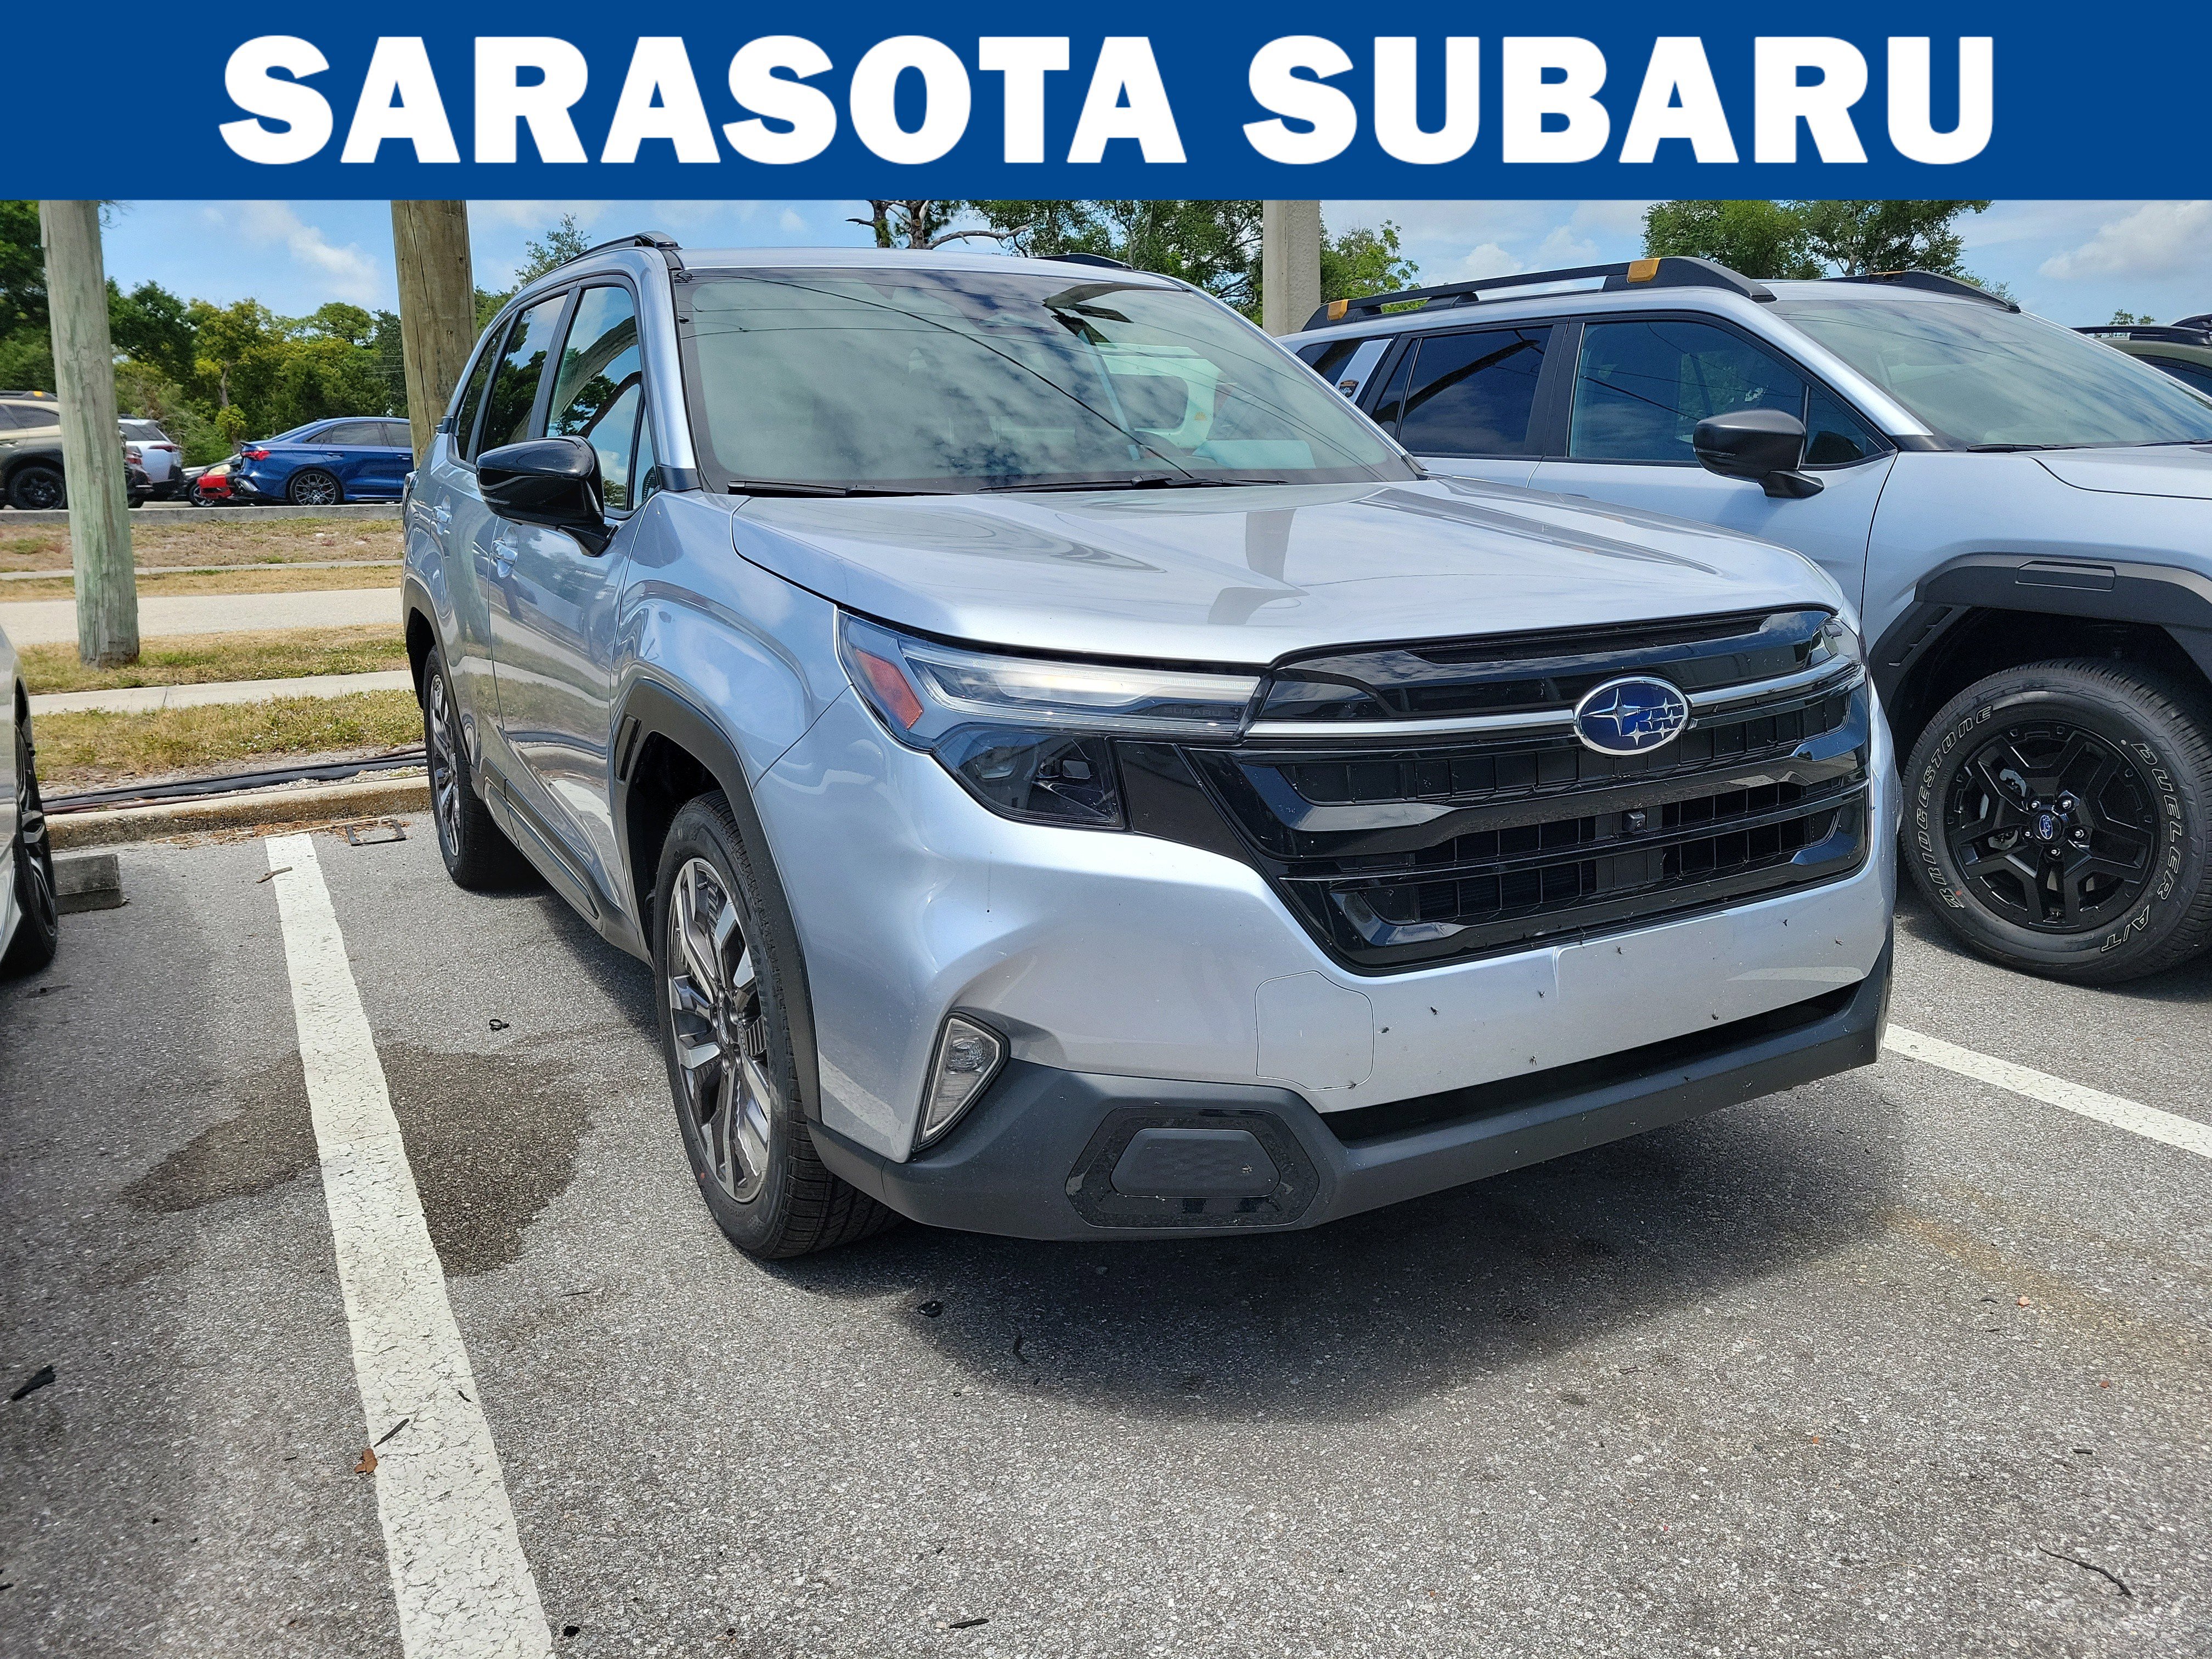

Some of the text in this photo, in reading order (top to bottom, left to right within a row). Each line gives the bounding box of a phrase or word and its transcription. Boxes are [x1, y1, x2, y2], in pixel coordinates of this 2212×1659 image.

[1163, 707, 1221, 717] SUBARU
[1916, 706, 1992, 909] BRIDGESTONE
[2101, 741, 2183, 952] DUELER A/T
